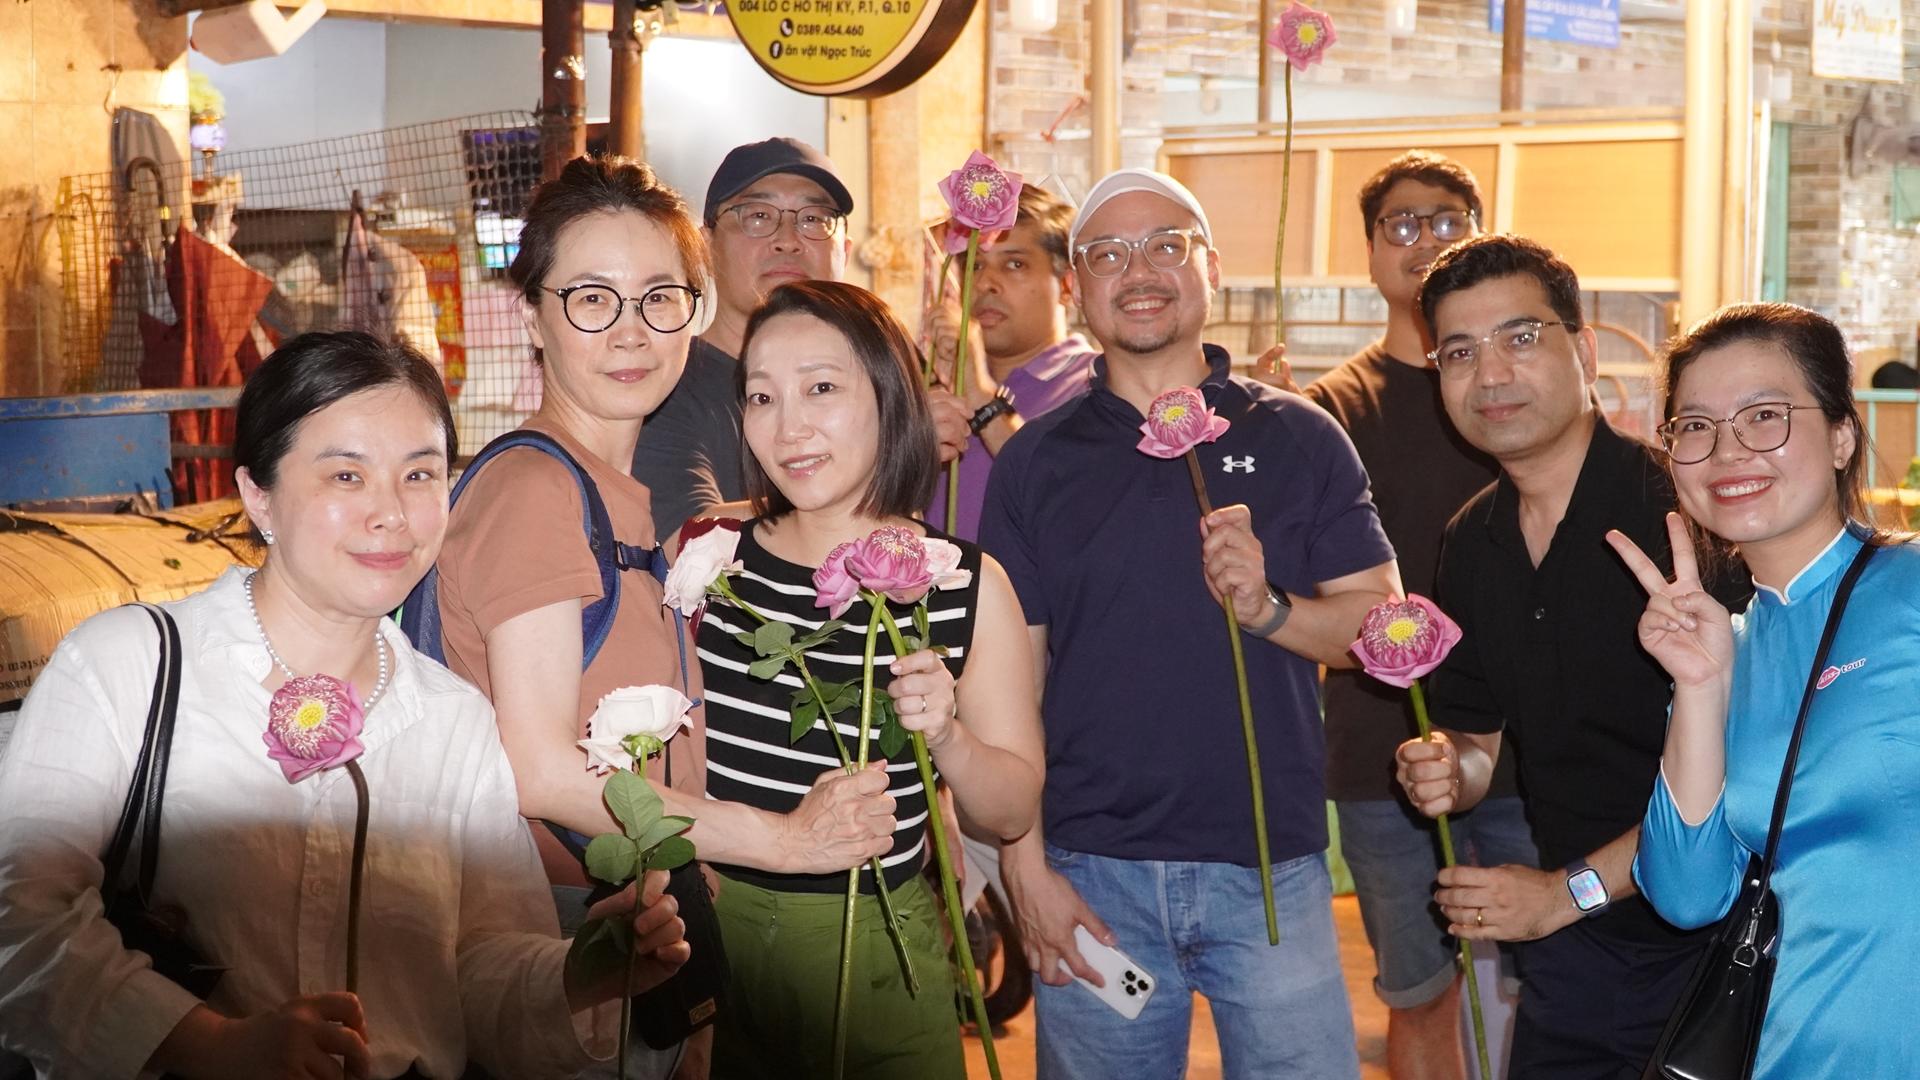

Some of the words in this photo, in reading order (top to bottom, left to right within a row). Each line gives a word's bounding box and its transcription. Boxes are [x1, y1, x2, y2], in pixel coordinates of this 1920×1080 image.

[739, 1, 760, 13] 004
[781, 1, 791, 13] C
[882, 1, 911, 14] Q.10
[796, 24, 864, 37] 0389.454.460
[820, 46, 847, 61] Ngọc
[850, 46, 872, 59] Trúc
[1841, 658, 1866, 673] tour
